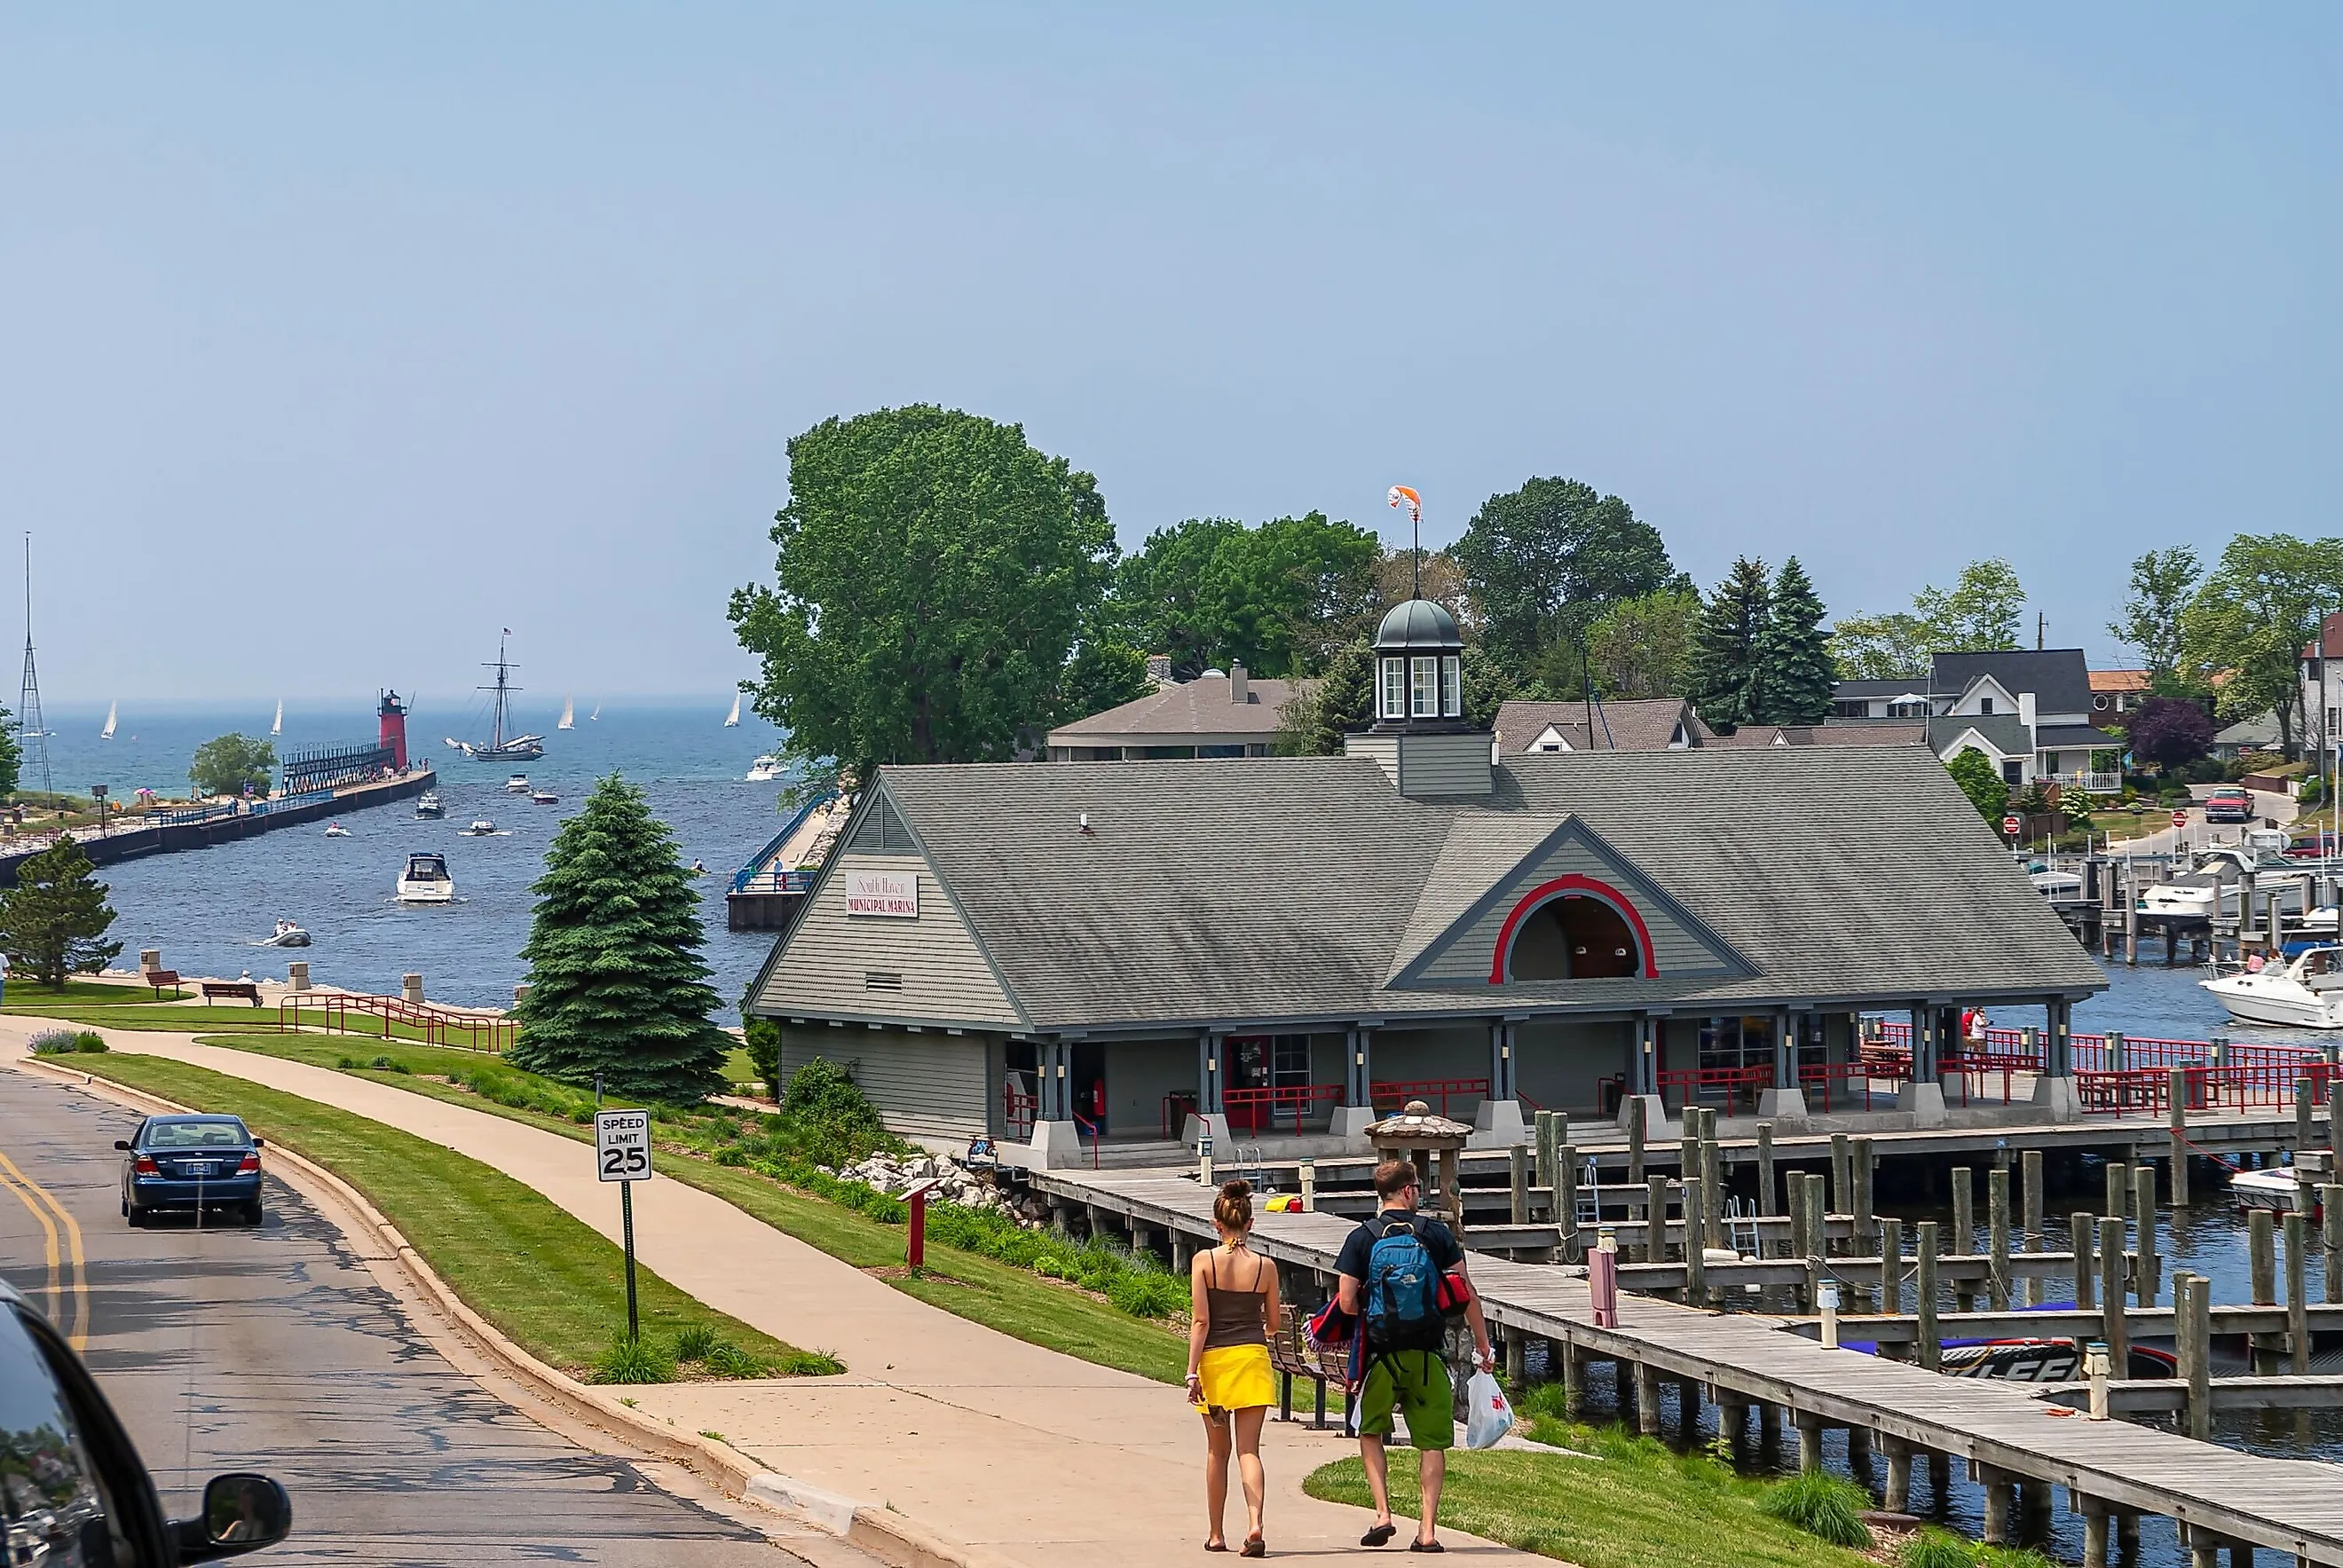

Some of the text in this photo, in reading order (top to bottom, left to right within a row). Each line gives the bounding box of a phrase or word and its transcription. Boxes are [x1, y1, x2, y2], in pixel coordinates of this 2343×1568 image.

[848, 898, 915, 913] MUNICIPAL MARINA
[603, 1118, 644, 1130] SPEED
[608, 1133, 639, 1145] LIMIT
[603, 1146, 646, 1174] 25
